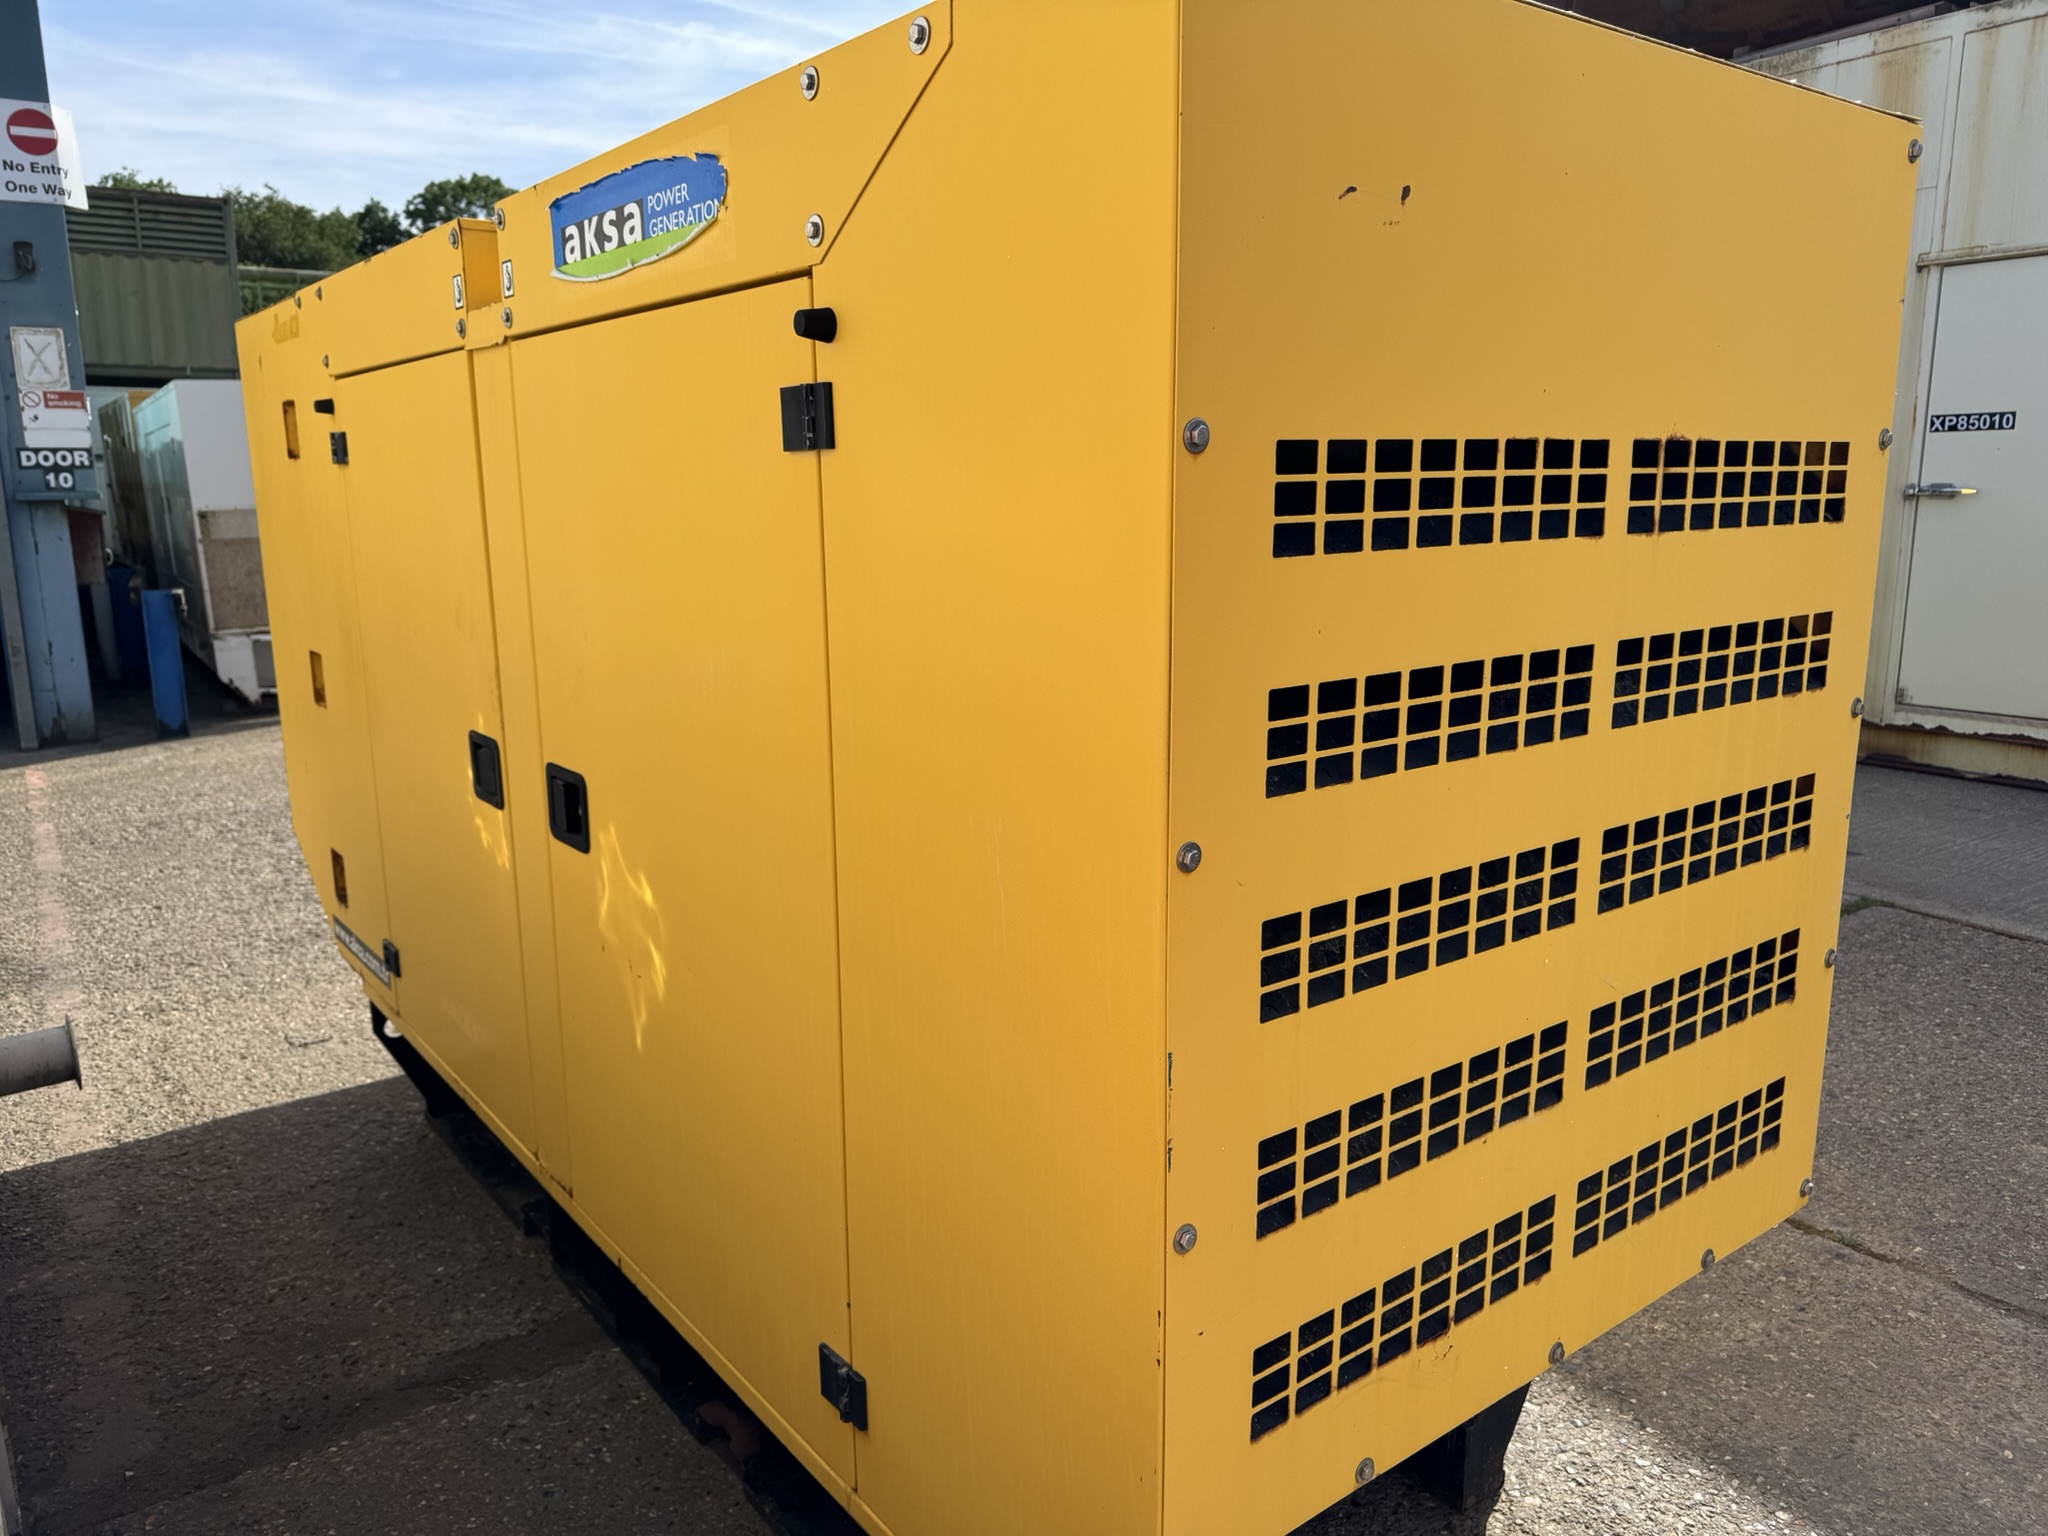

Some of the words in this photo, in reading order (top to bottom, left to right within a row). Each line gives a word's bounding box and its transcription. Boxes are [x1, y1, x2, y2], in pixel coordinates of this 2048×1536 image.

[3, 160, 25, 172] No
[30, 162, 68, 178] Entry
[5, 181, 38, 194] One
[42, 183, 72, 199] Way
[648, 183, 689, 214] POWER
[565, 202, 642, 264] aksa
[47, 400, 82, 408] smoking
[1931, 414, 2013, 431] XP85010
[20, 451, 90, 466] DOOR
[45, 472, 74, 488] 10
